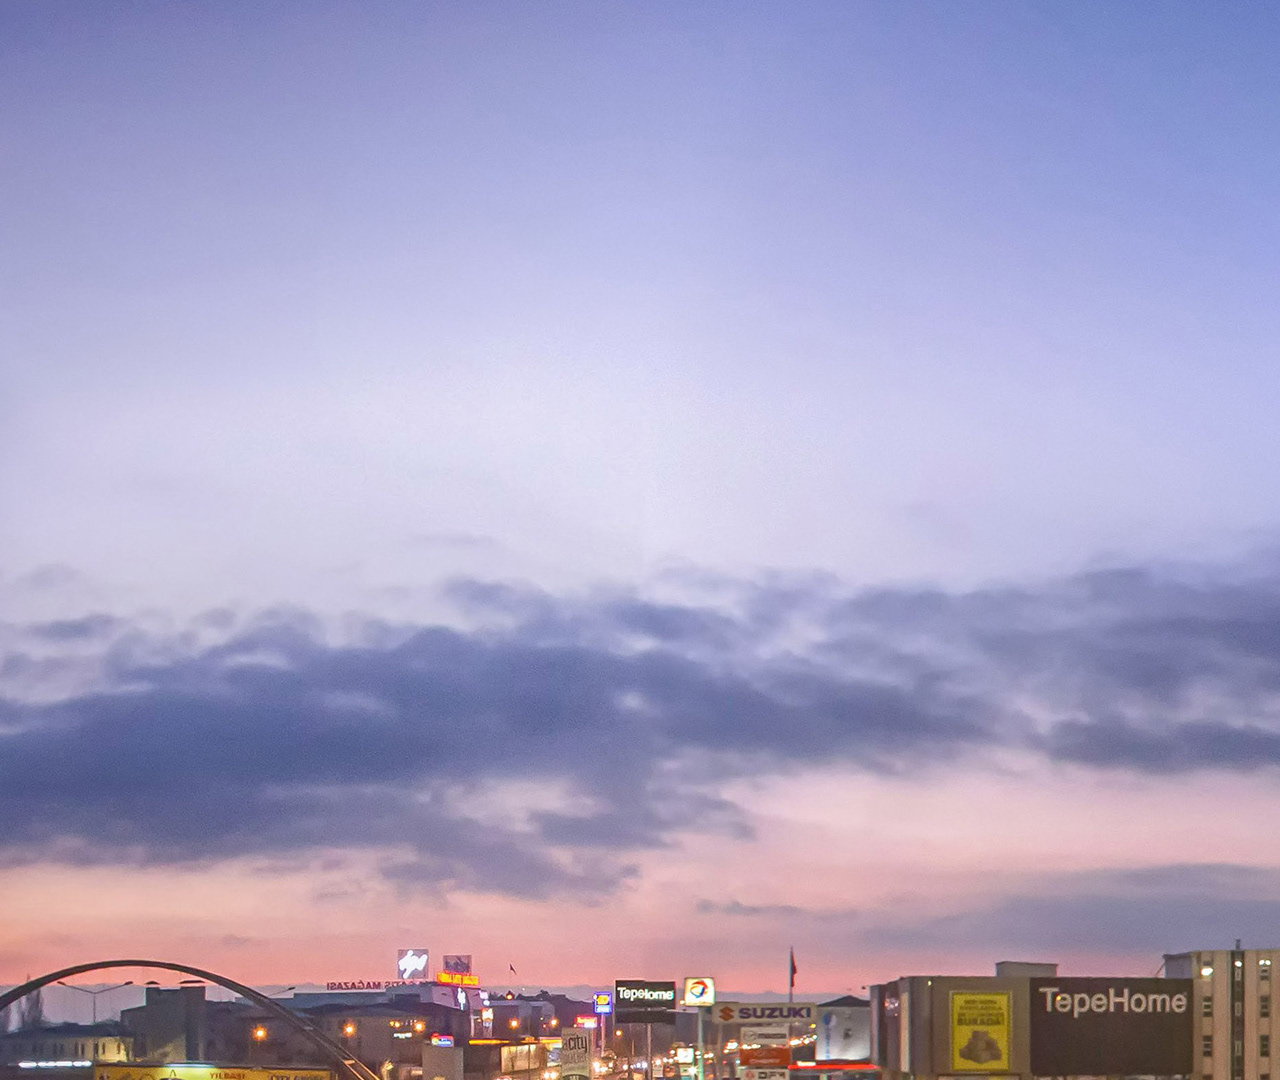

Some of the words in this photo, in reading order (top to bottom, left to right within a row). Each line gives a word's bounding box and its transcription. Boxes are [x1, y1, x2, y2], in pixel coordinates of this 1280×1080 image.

[616, 987, 675, 1001] TepeHome
[1039, 987, 1187, 1018] TepeHome
[738, 1006, 812, 1019] SUZUKI
